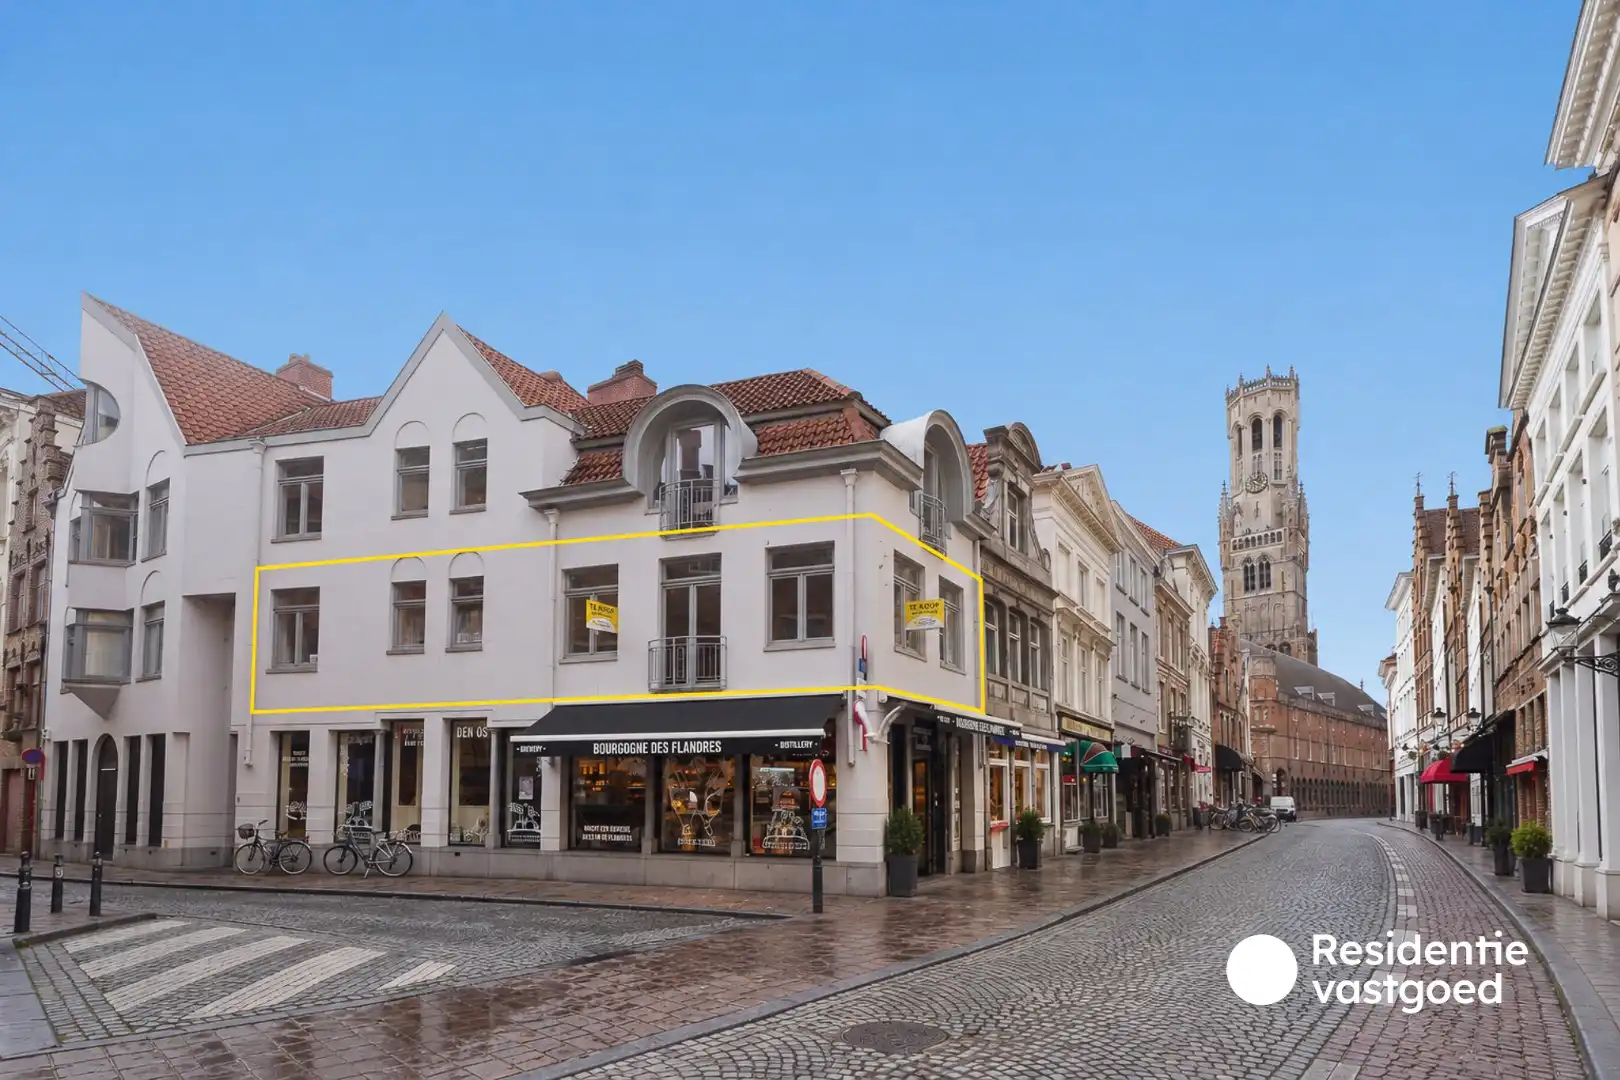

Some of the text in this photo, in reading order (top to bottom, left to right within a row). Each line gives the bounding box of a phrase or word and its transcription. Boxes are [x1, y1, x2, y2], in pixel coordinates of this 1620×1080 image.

[910, 602, 940, 611] TE KOOP
[456, 726, 474, 738] DEN
[593, 740, 722, 755] BOURGOGNE DES FLANDRES
[780, 740, 813, 749] DISTILLERY
